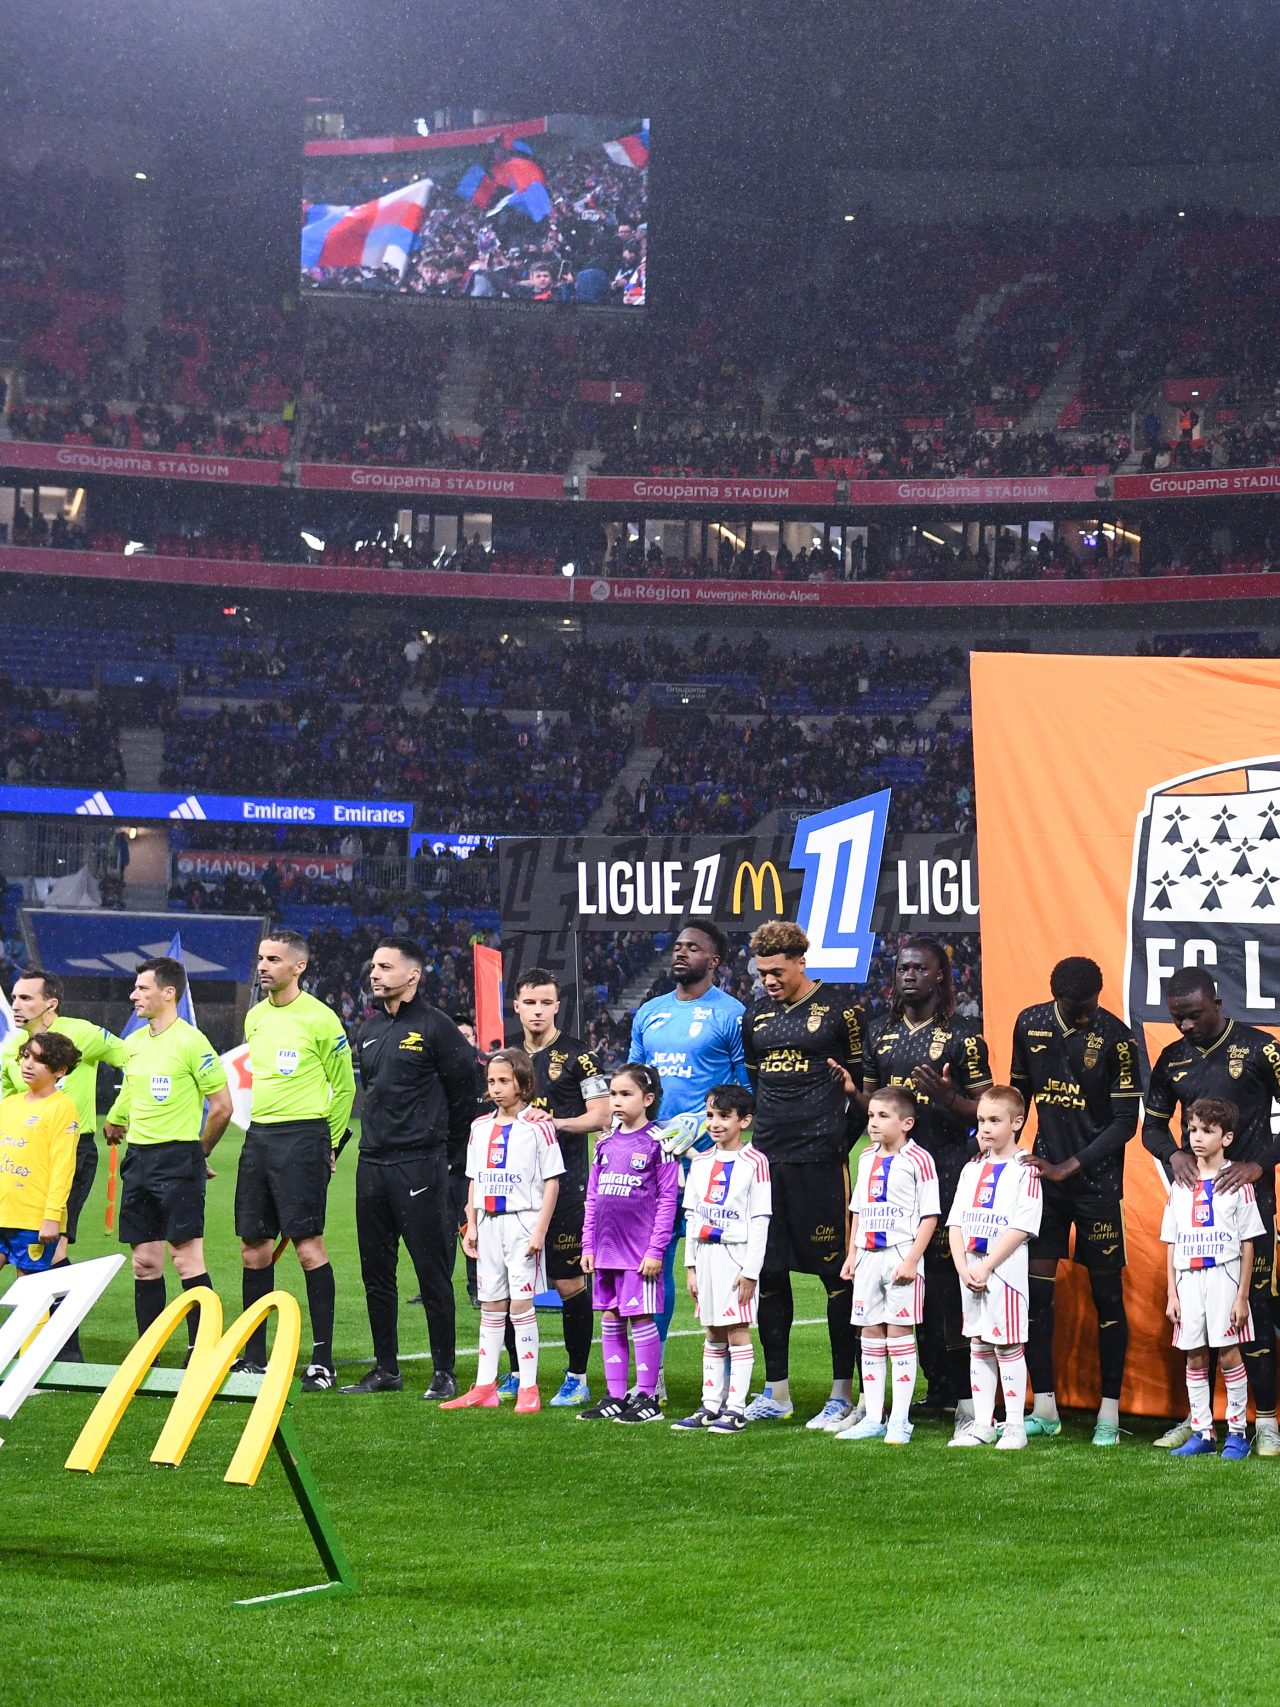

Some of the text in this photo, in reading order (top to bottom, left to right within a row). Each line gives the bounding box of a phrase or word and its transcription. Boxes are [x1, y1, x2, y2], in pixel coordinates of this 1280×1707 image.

[57, 449, 229, 476] Groupama STADIUM
[351, 469, 515, 492] Groupama STADIUM
[1150, 477, 1229, 493] Groupama
[634, 481, 790, 499] Groupama STADIUM
[898, 484, 1050, 500] Groupama STADIUM
[696, 588, 820, 602] Auvergne-Rhône-Alpes
[244, 801, 315, 820] Emirates
[334, 805, 405, 823] Emirates
[577, 861, 684, 914] LIGUE
[898, 859, 981, 915] LIGU
[843, 1009, 863, 1055] actual
[279, 1050, 297, 1058] FIFA
[651, 1052, 686, 1064] JEAN
[766, 1050, 802, 1061] JEAN
[964, 1037, 982, 1079] actual
[658, 1065, 692, 1078] OC'H
[761, 1059, 809, 1073] FLOC'H
[1117, 1042, 1134, 1089] actual
[887, 1076, 916, 1090] JEA
[1044, 1078, 1080, 1095] JEAN
[600, 1172, 643, 1187] mirates
[490, 1184, 514, 1195] BETTER
[861, 1205, 904, 1218] mirates
[962, 1211, 1009, 1226] Emirates
[874, 1218, 896, 1230] BETTER
[1177, 1231, 1233, 1243] Emirates
[1197, 1244, 1225, 1255] BETTER
